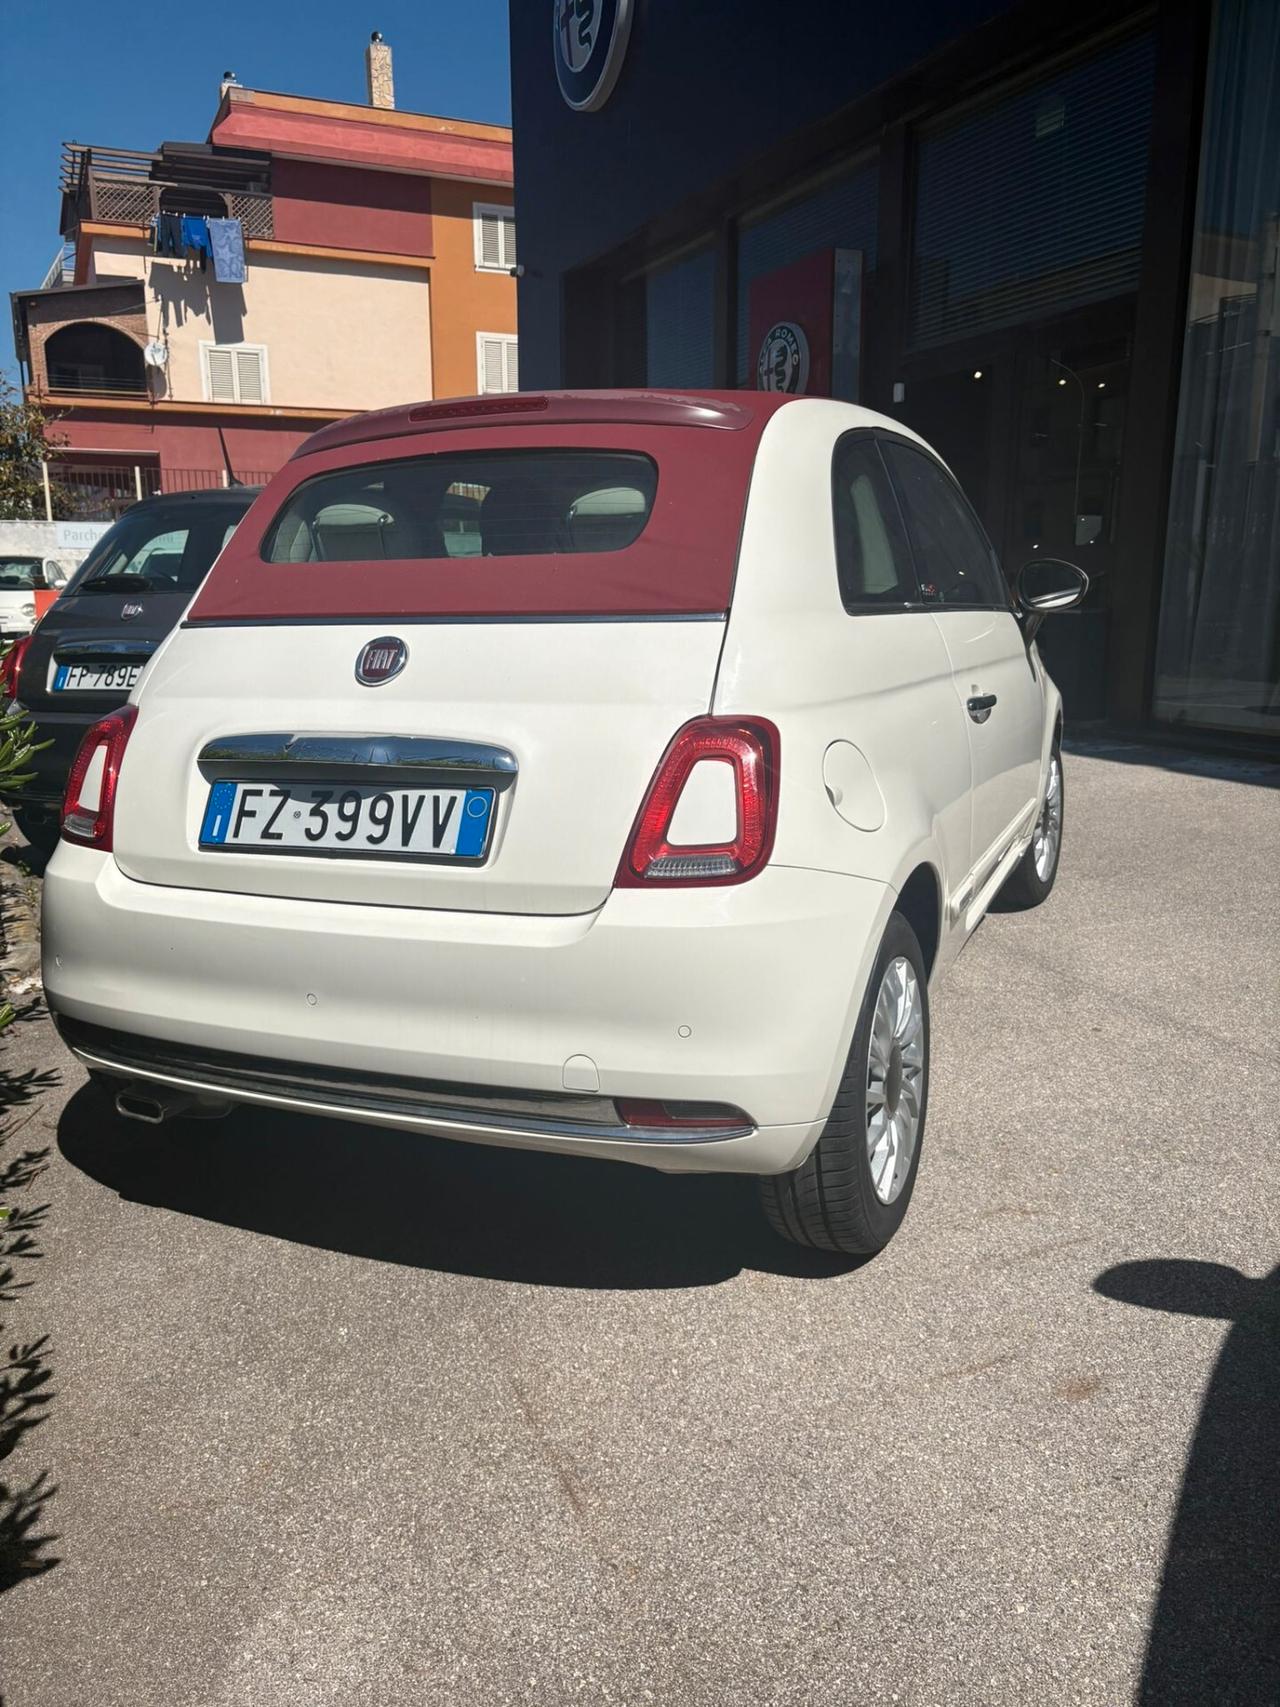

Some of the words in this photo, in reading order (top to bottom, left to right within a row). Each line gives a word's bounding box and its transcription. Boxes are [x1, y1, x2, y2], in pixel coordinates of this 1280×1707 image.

[364, 648, 398, 670] FIAT
[66, 665, 90, 687] FP
[232, 788, 292, 841] FZ
[304, 790, 458, 849] 399VV
